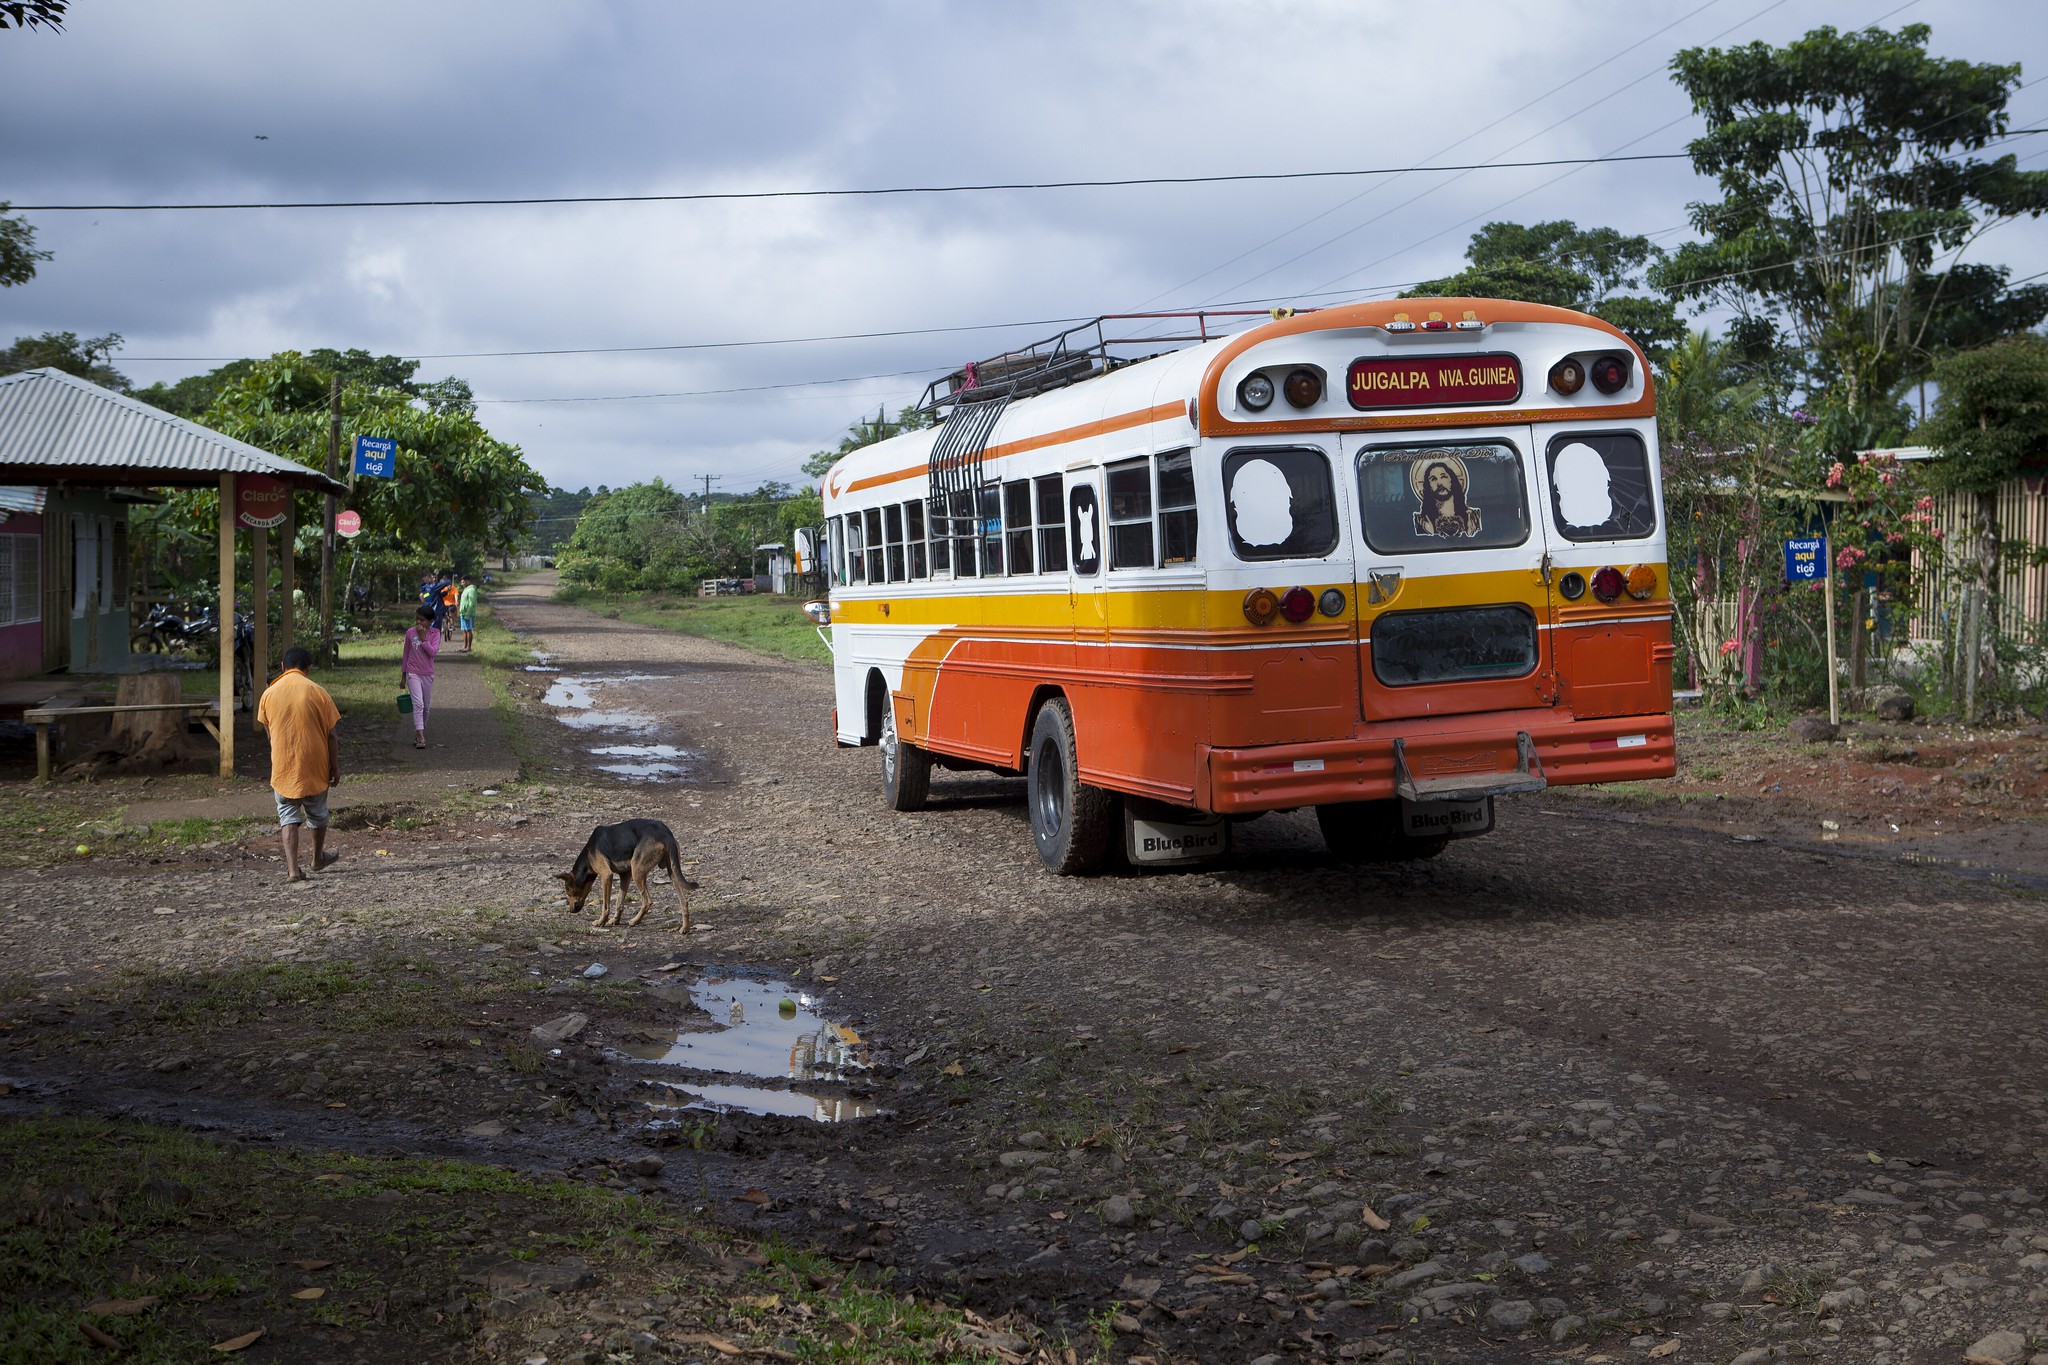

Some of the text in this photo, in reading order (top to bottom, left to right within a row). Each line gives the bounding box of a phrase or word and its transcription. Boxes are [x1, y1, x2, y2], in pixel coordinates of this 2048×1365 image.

[1352, 371, 1430, 391] JUIGALPA
[362, 438, 391, 451] Recargá
[1465, 447, 1496, 459] Dios
[242, 487, 281, 502] Claro
[339, 517, 358, 525] Claro
[1789, 539, 1820, 551] Recargá
